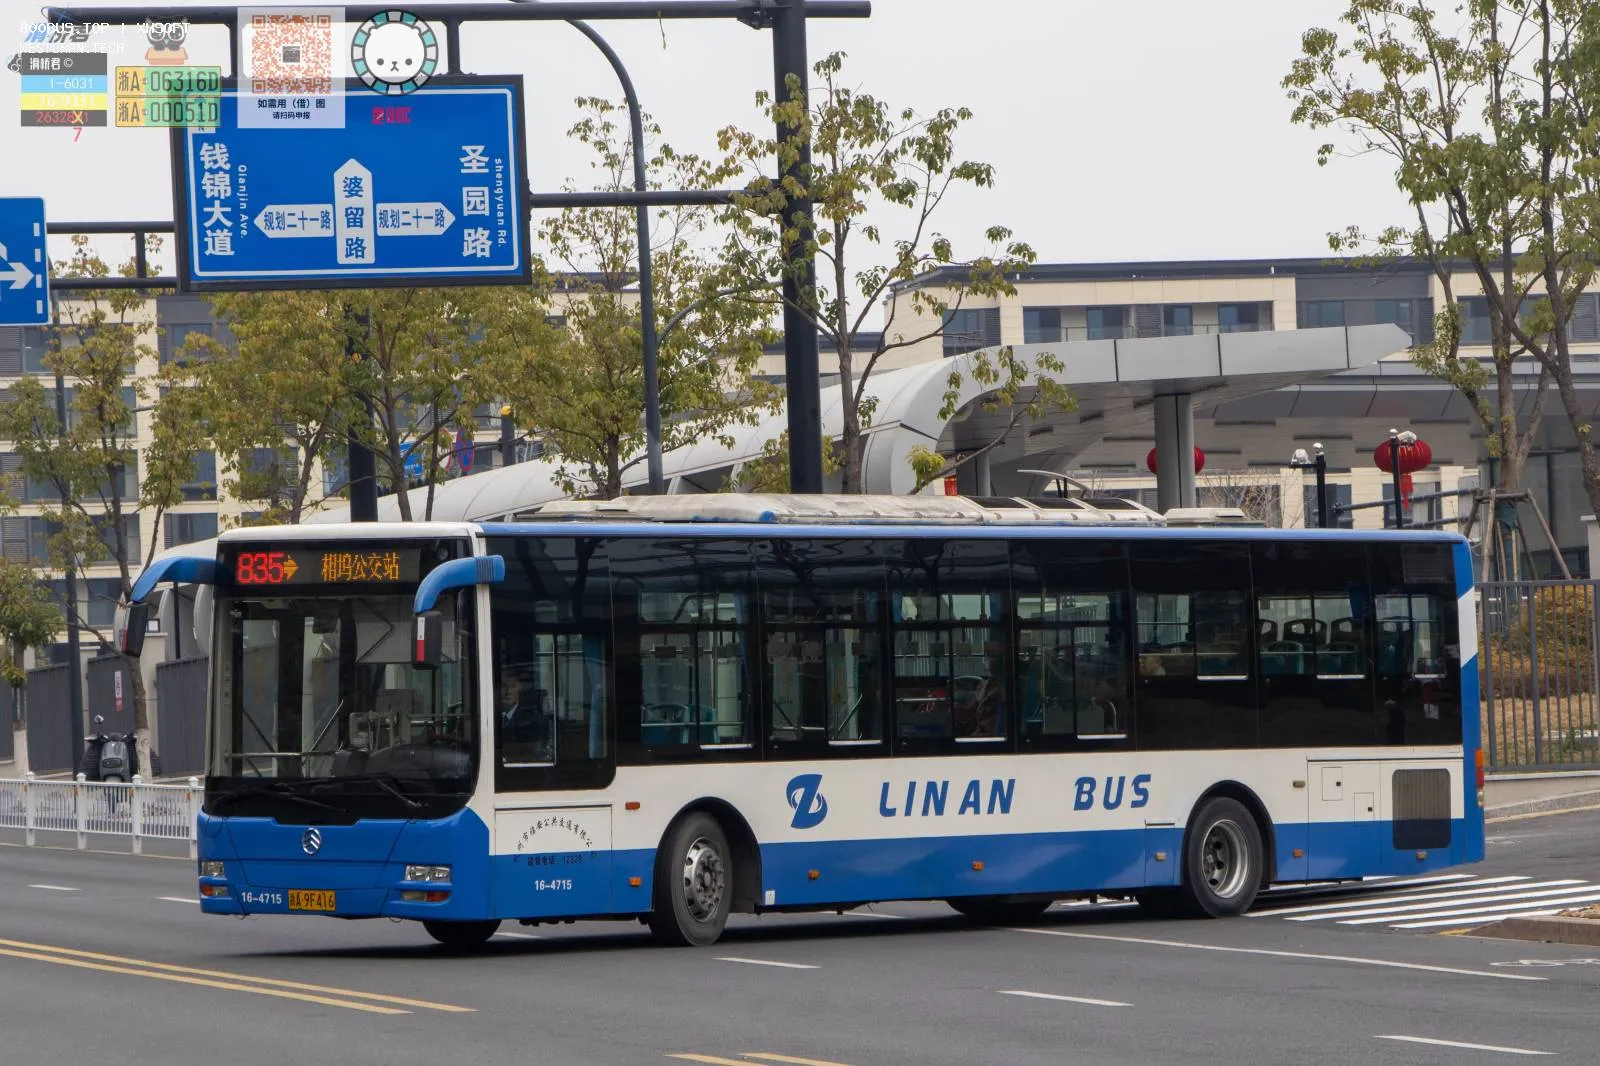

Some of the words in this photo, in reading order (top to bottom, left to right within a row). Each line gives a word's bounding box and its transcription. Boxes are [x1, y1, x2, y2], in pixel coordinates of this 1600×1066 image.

[200, 143, 235, 256] 钱锦大道
[459, 145, 493, 257] 圣园路
[239, 213, 249, 239] Ave.
[263, 211, 332, 231] 规划二十一路
[342, 176, 369, 260] 婆留路
[378, 208, 446, 229] 规划二十一路
[497, 229, 507, 248] Rd.
[237, 552, 284, 584] 835
[879, 778, 1016, 818] LINAN
[1073, 773, 1152, 811] BUS
[241, 891, 282, 905] 16-4715
[534, 879, 572, 892] 16-4715
